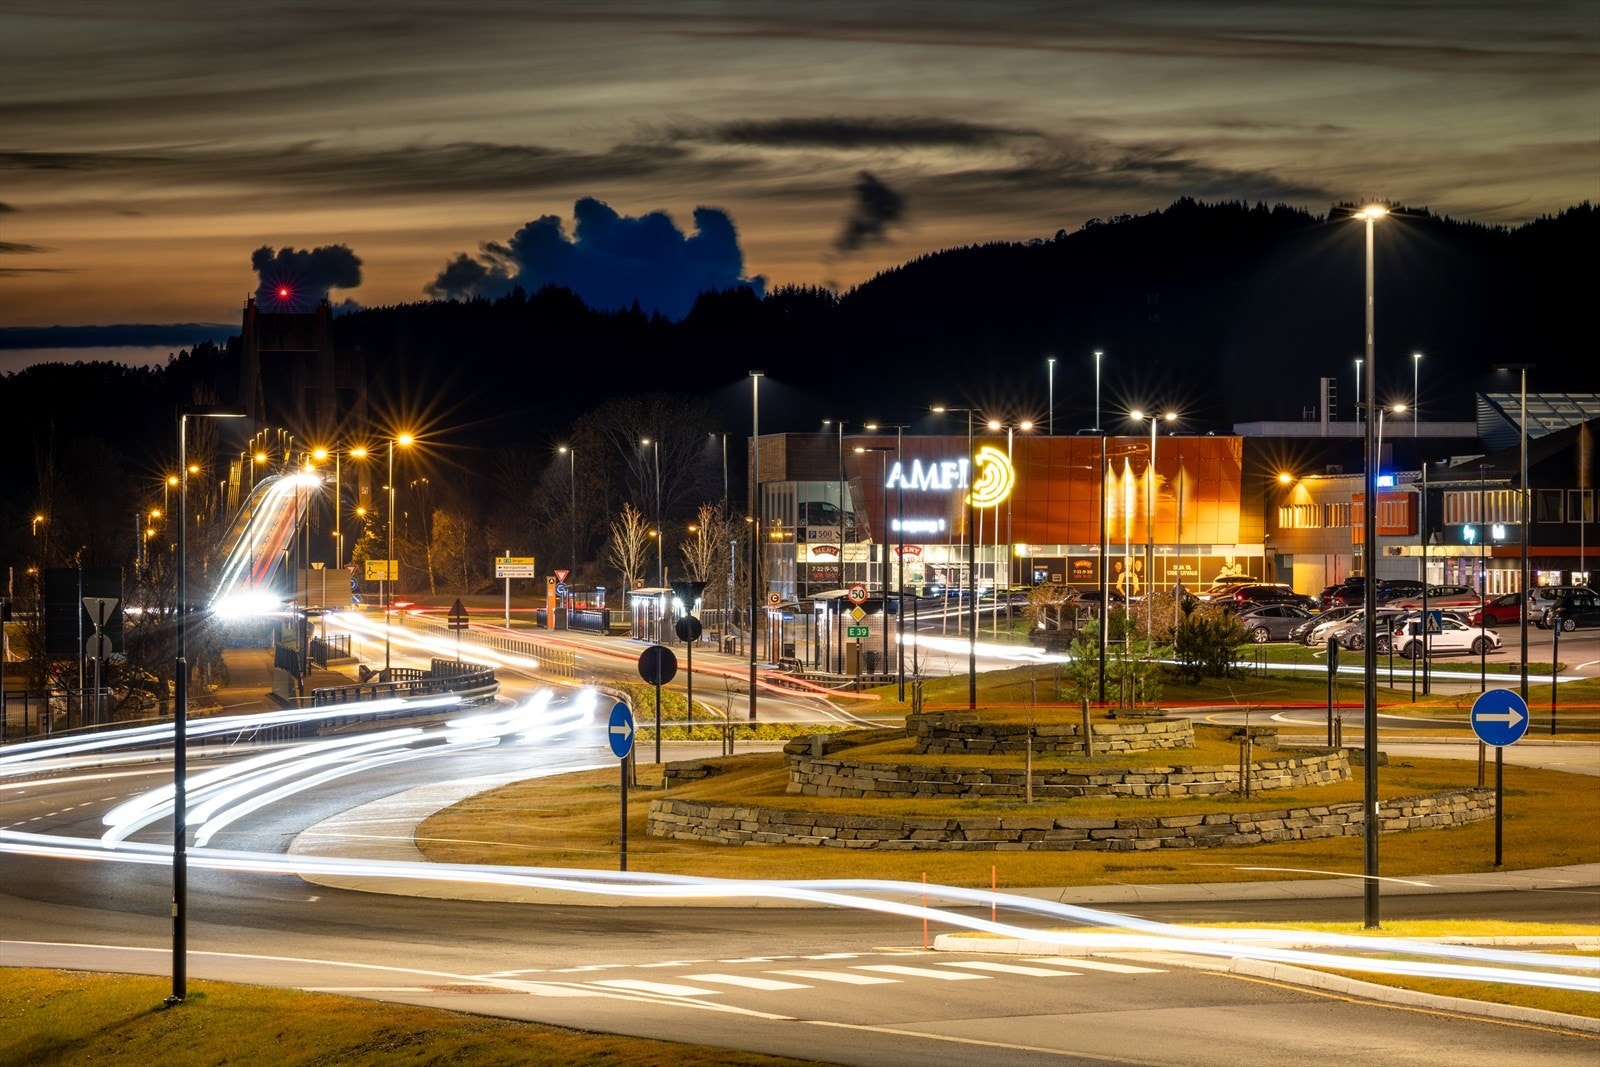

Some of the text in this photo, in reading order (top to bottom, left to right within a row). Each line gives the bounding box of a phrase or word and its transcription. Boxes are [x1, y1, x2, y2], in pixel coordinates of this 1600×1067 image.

[886, 459, 969, 491] AMFI
[818, 530, 832, 538] 500
[813, 546, 838, 555] MENY
[852, 589, 864, 599] 50
